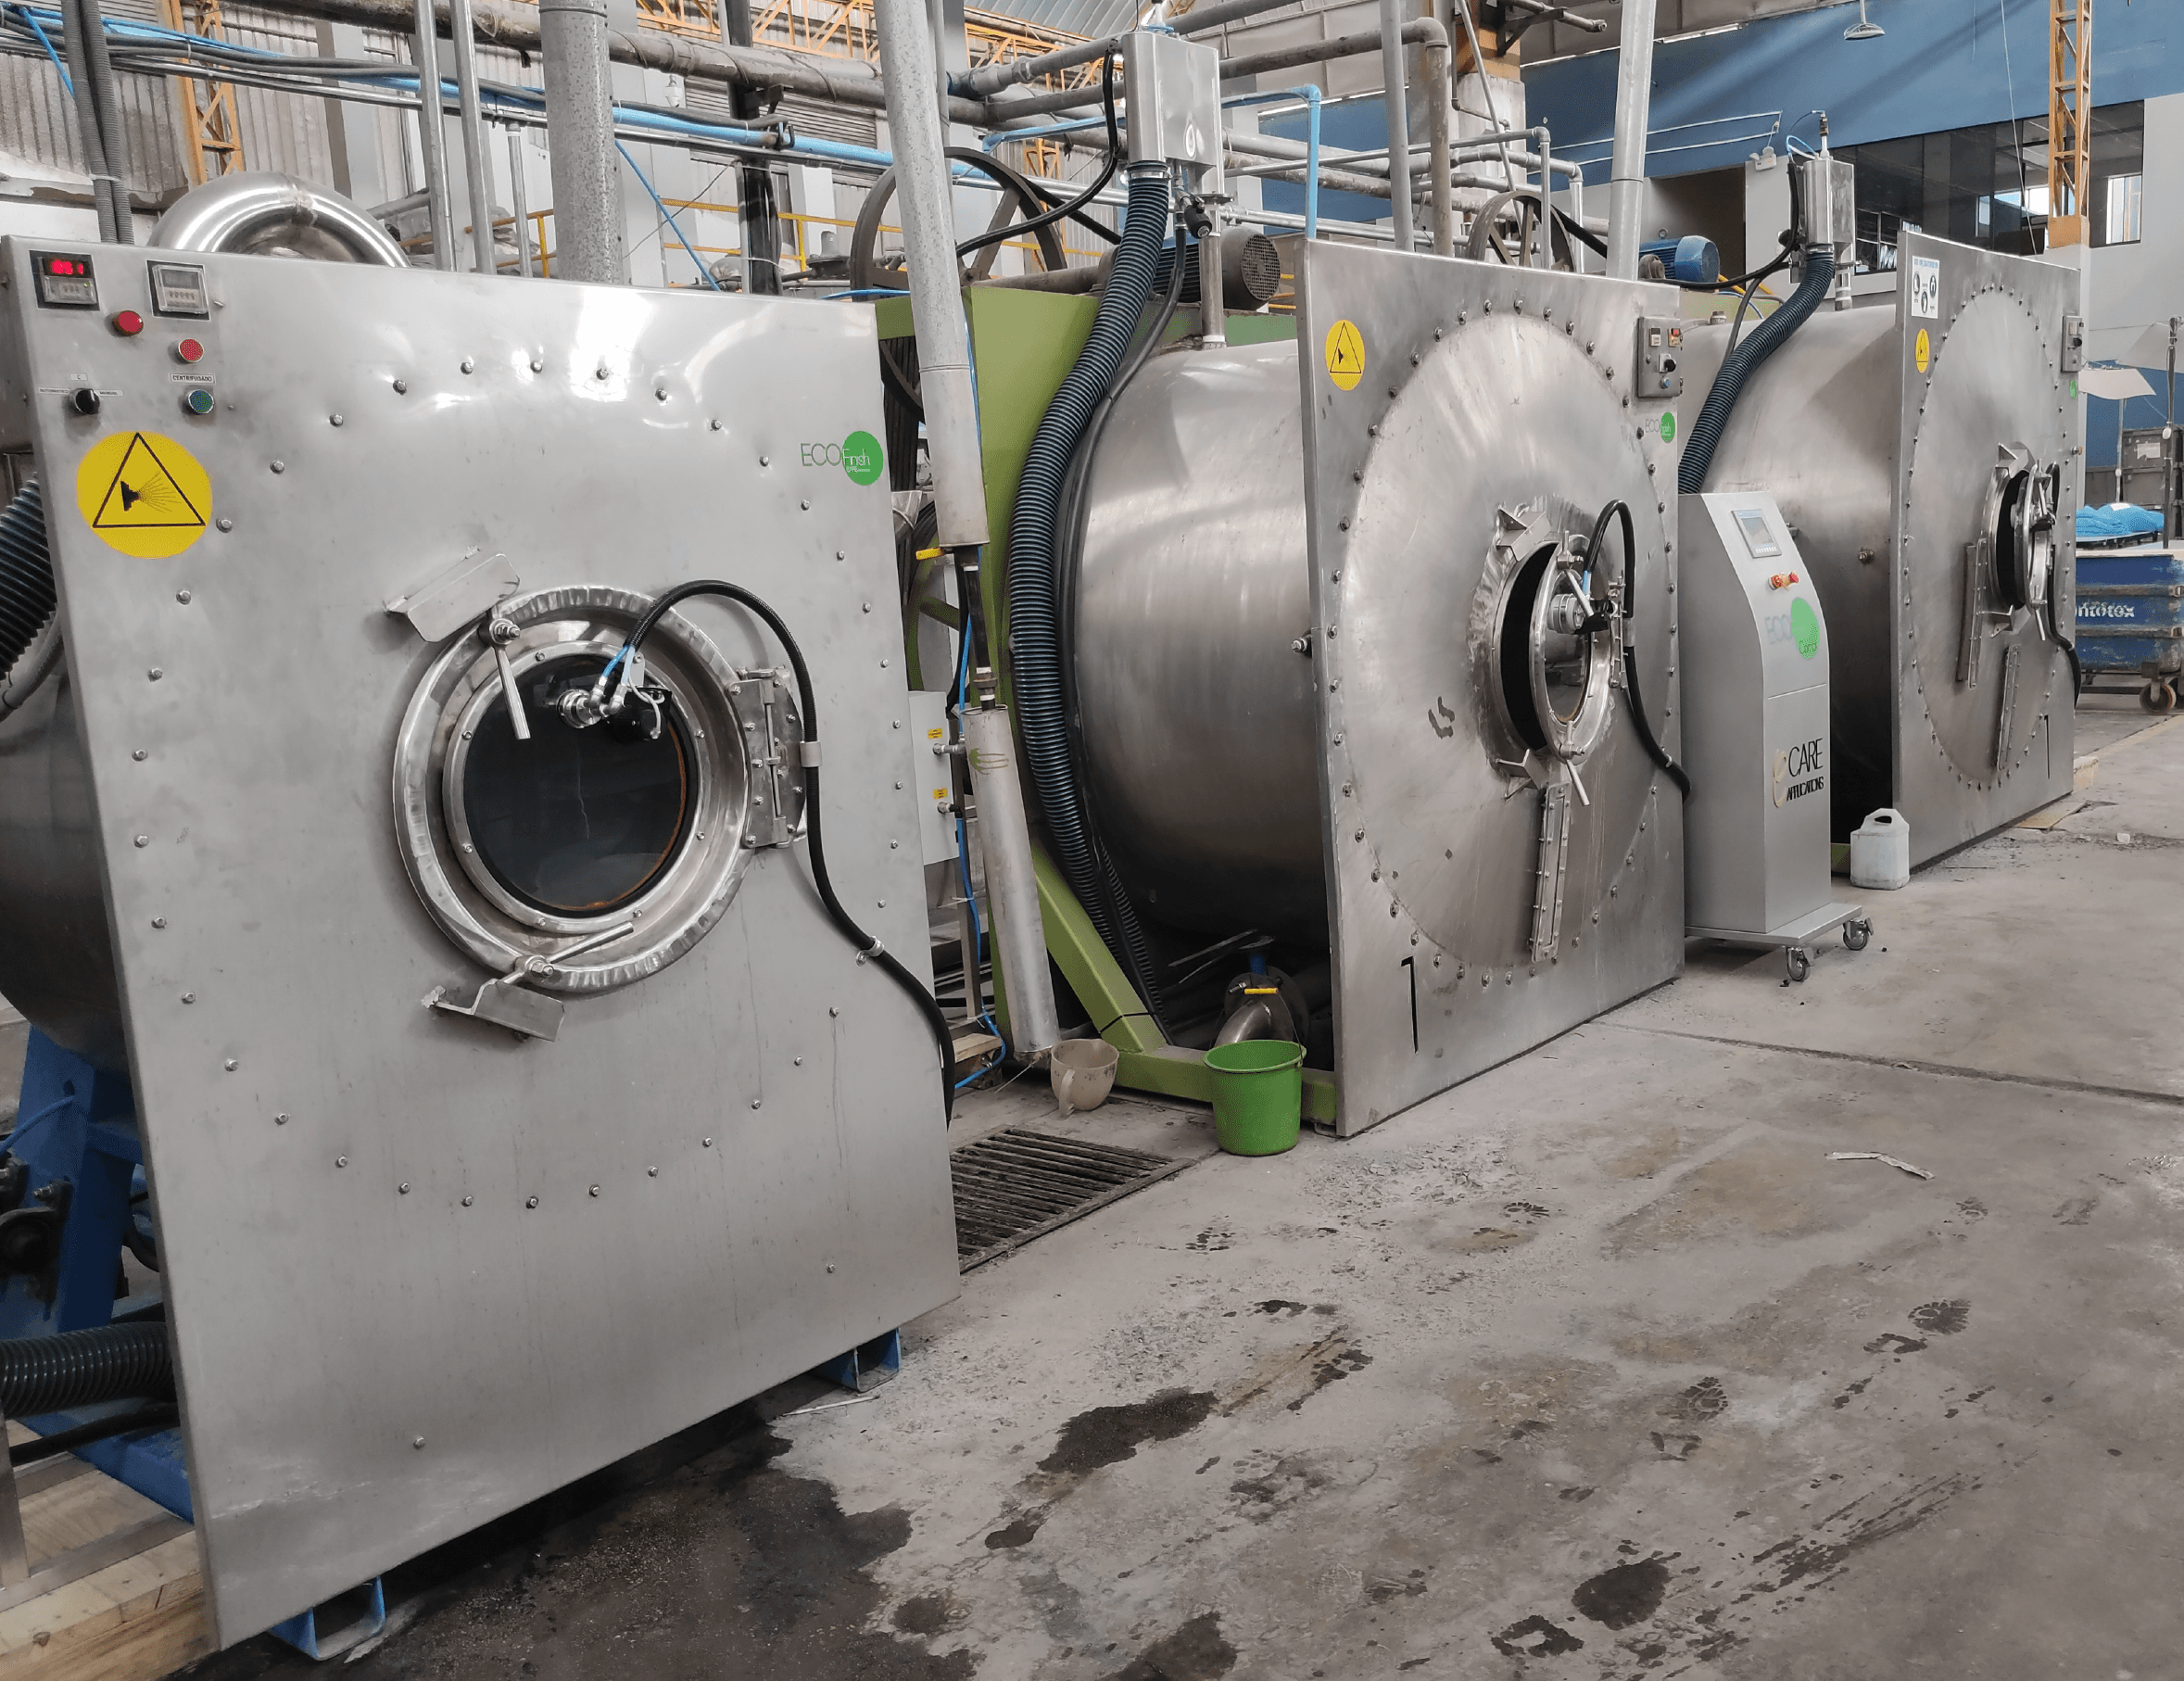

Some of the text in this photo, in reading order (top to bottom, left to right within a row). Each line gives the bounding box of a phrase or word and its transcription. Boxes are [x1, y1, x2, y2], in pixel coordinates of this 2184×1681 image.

[800, 442, 841, 467] ECO
[1788, 737, 1824, 777] CARE
[1786, 776, 1824, 802] APPLICATIONS
